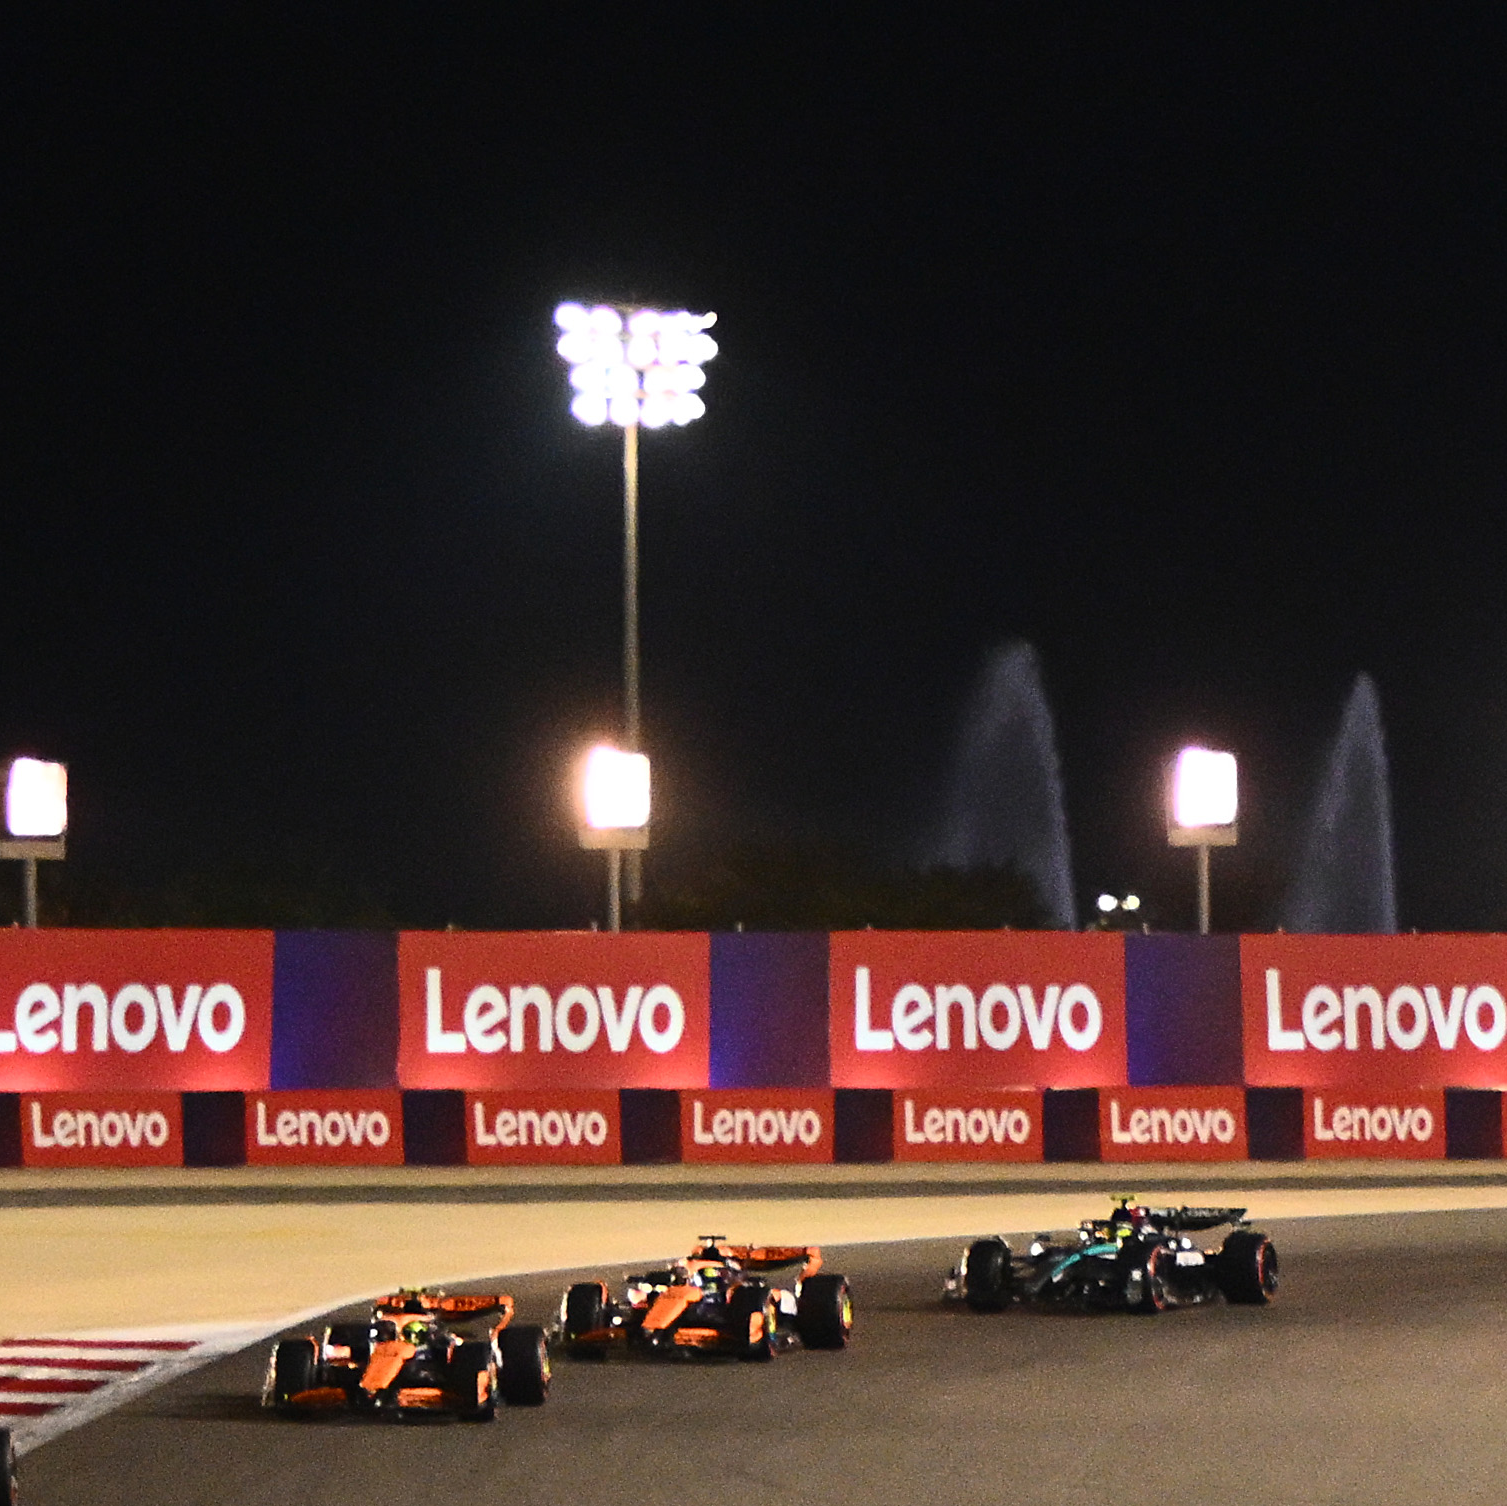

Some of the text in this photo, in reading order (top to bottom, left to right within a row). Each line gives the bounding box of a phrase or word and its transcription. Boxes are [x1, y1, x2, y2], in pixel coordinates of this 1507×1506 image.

[426, 968, 685, 1053] Lenovo
[855, 967, 1102, 1051] Lenovo
[1266, 968, 1507, 1051] Lenovo
[32, 1102, 168, 1147] Lenovo
[257, 1102, 389, 1146] Lenovo
[475, 1102, 607, 1146] Lenovo
[694, 1101, 821, 1144] Lenovo
[905, 1100, 1030, 1143] Lenovo
[1111, 1101, 1234, 1143] Lenovo
[1314, 1099, 1432, 1141] Lenovo
